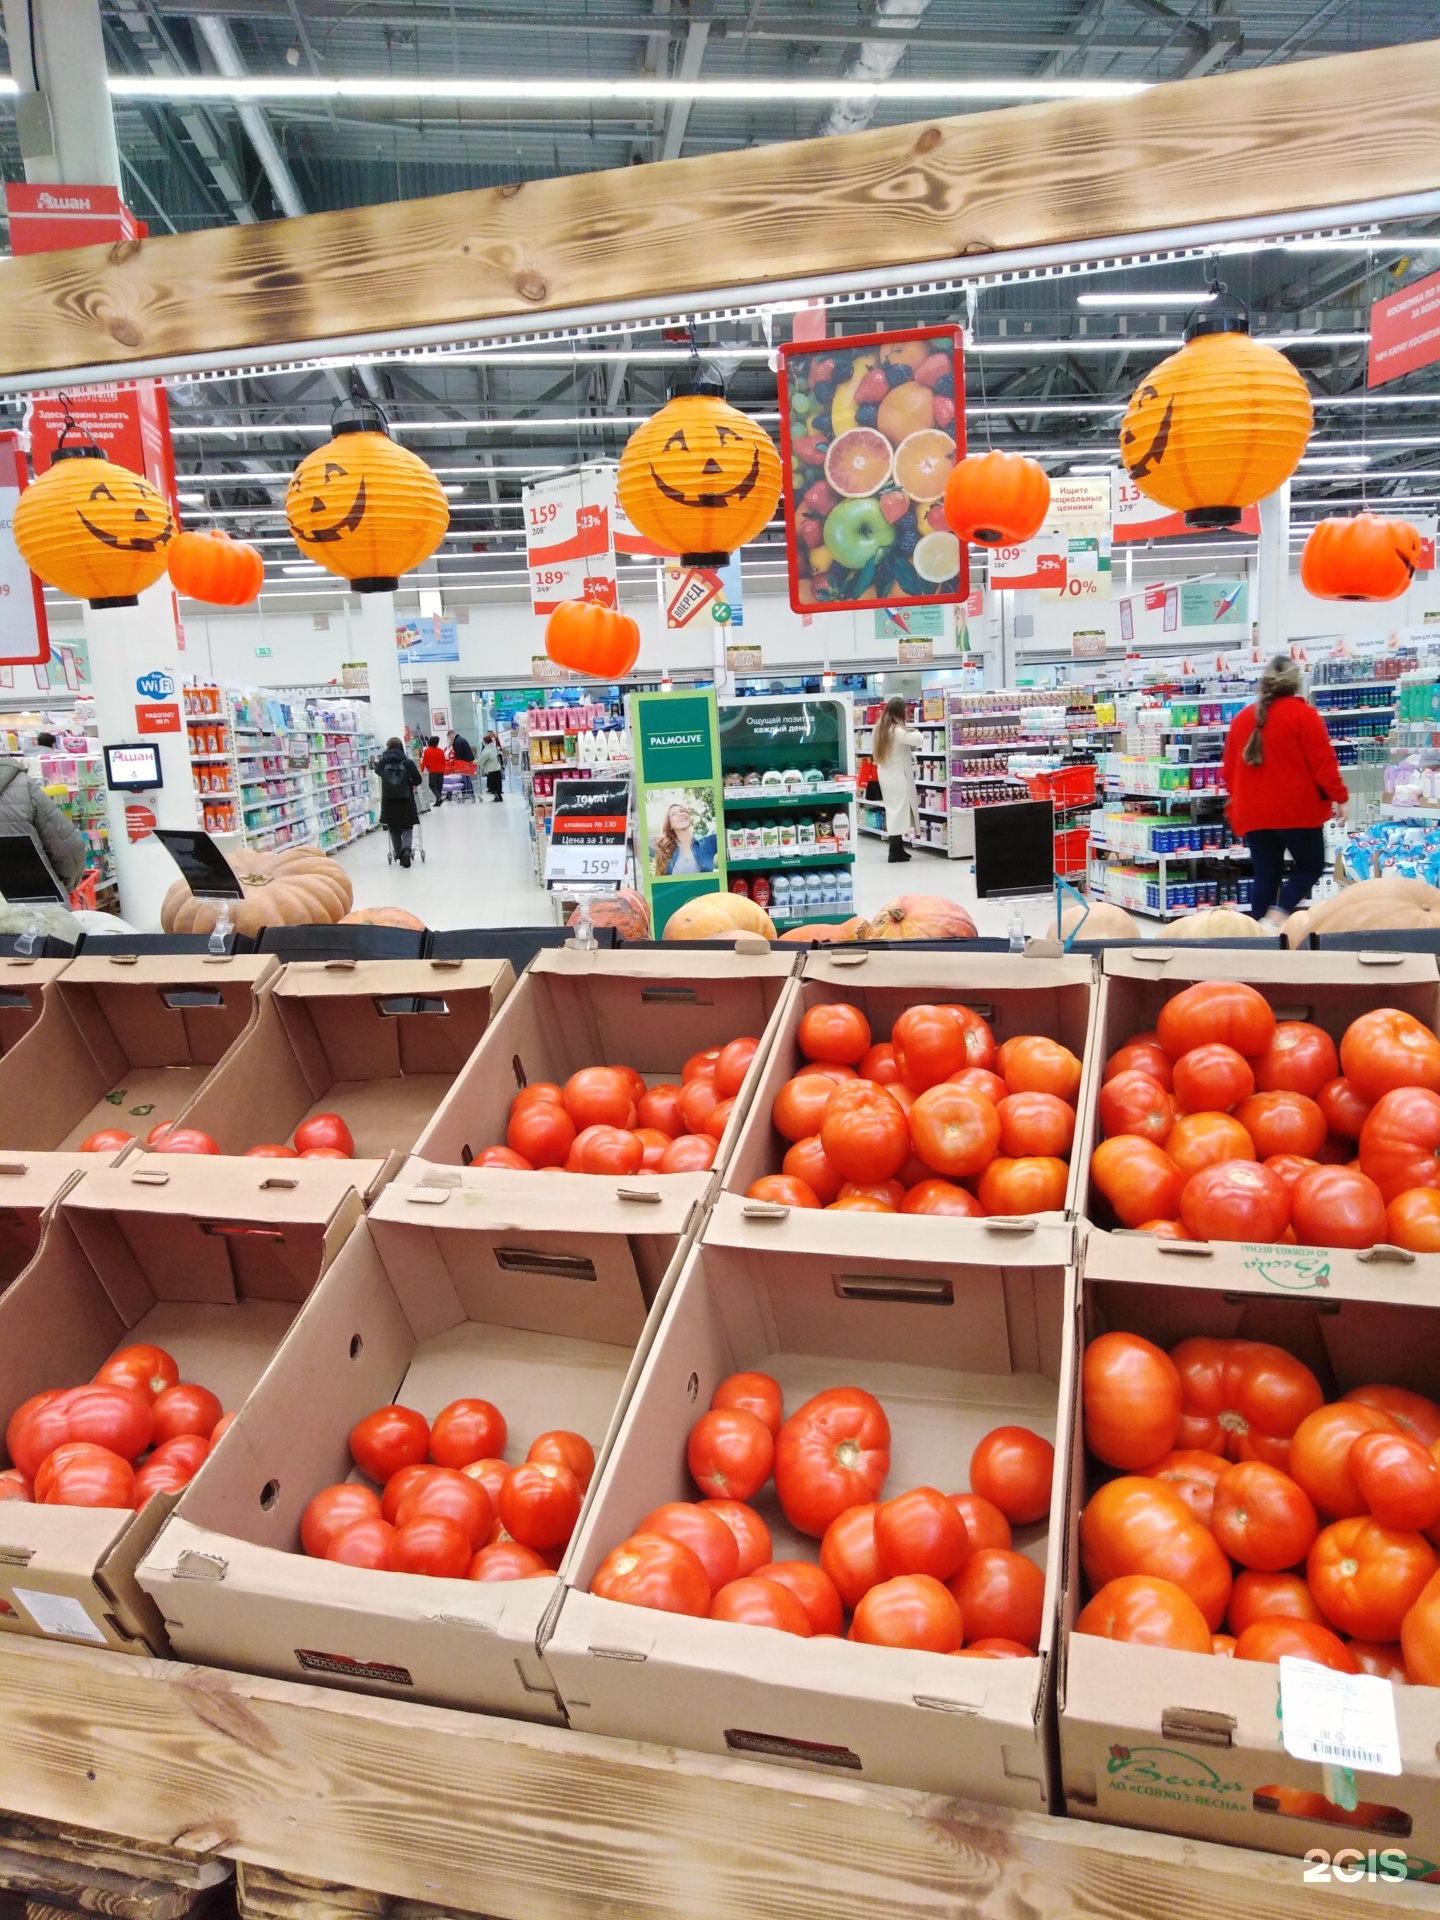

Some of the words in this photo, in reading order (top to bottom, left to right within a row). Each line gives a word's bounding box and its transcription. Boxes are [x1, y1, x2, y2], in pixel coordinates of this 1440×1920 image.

[36, 192, 91, 210] Ашан
[98, 411, 130, 420] узнать
[1118, 484, 1148, 502] 13
[1049, 495, 1103, 504] пециальные
[1057, 504, 1093, 512] ценники
[530, 503, 557, 526] 159
[577, 514, 601, 529] -23%
[994, 548, 1020, 561] 109
[1037, 560, 1061, 570] -29%
[535, 571, 564, 585] 189
[584, 583, 610, 593] -24%
[673, 583, 705, 618] ВПЕРЕД
[145, 711, 174, 719] РАБОТАЕТ
[746, 715, 781, 727] Ощущай
[754, 725, 788, 735] каждый
[788, 724, 809, 733] день
[650, 735, 702, 746] PALMOLIVE
[112, 751, 154, 762] Ашан
[576, 794, 608, 804] ТОМАТ
[561, 835, 585, 846] Цена
[598, 835, 604, 844] 1
[606, 836, 616, 844] кг
[581, 860, 611, 875] 159
[1109, 1780, 1127, 1791] АО
